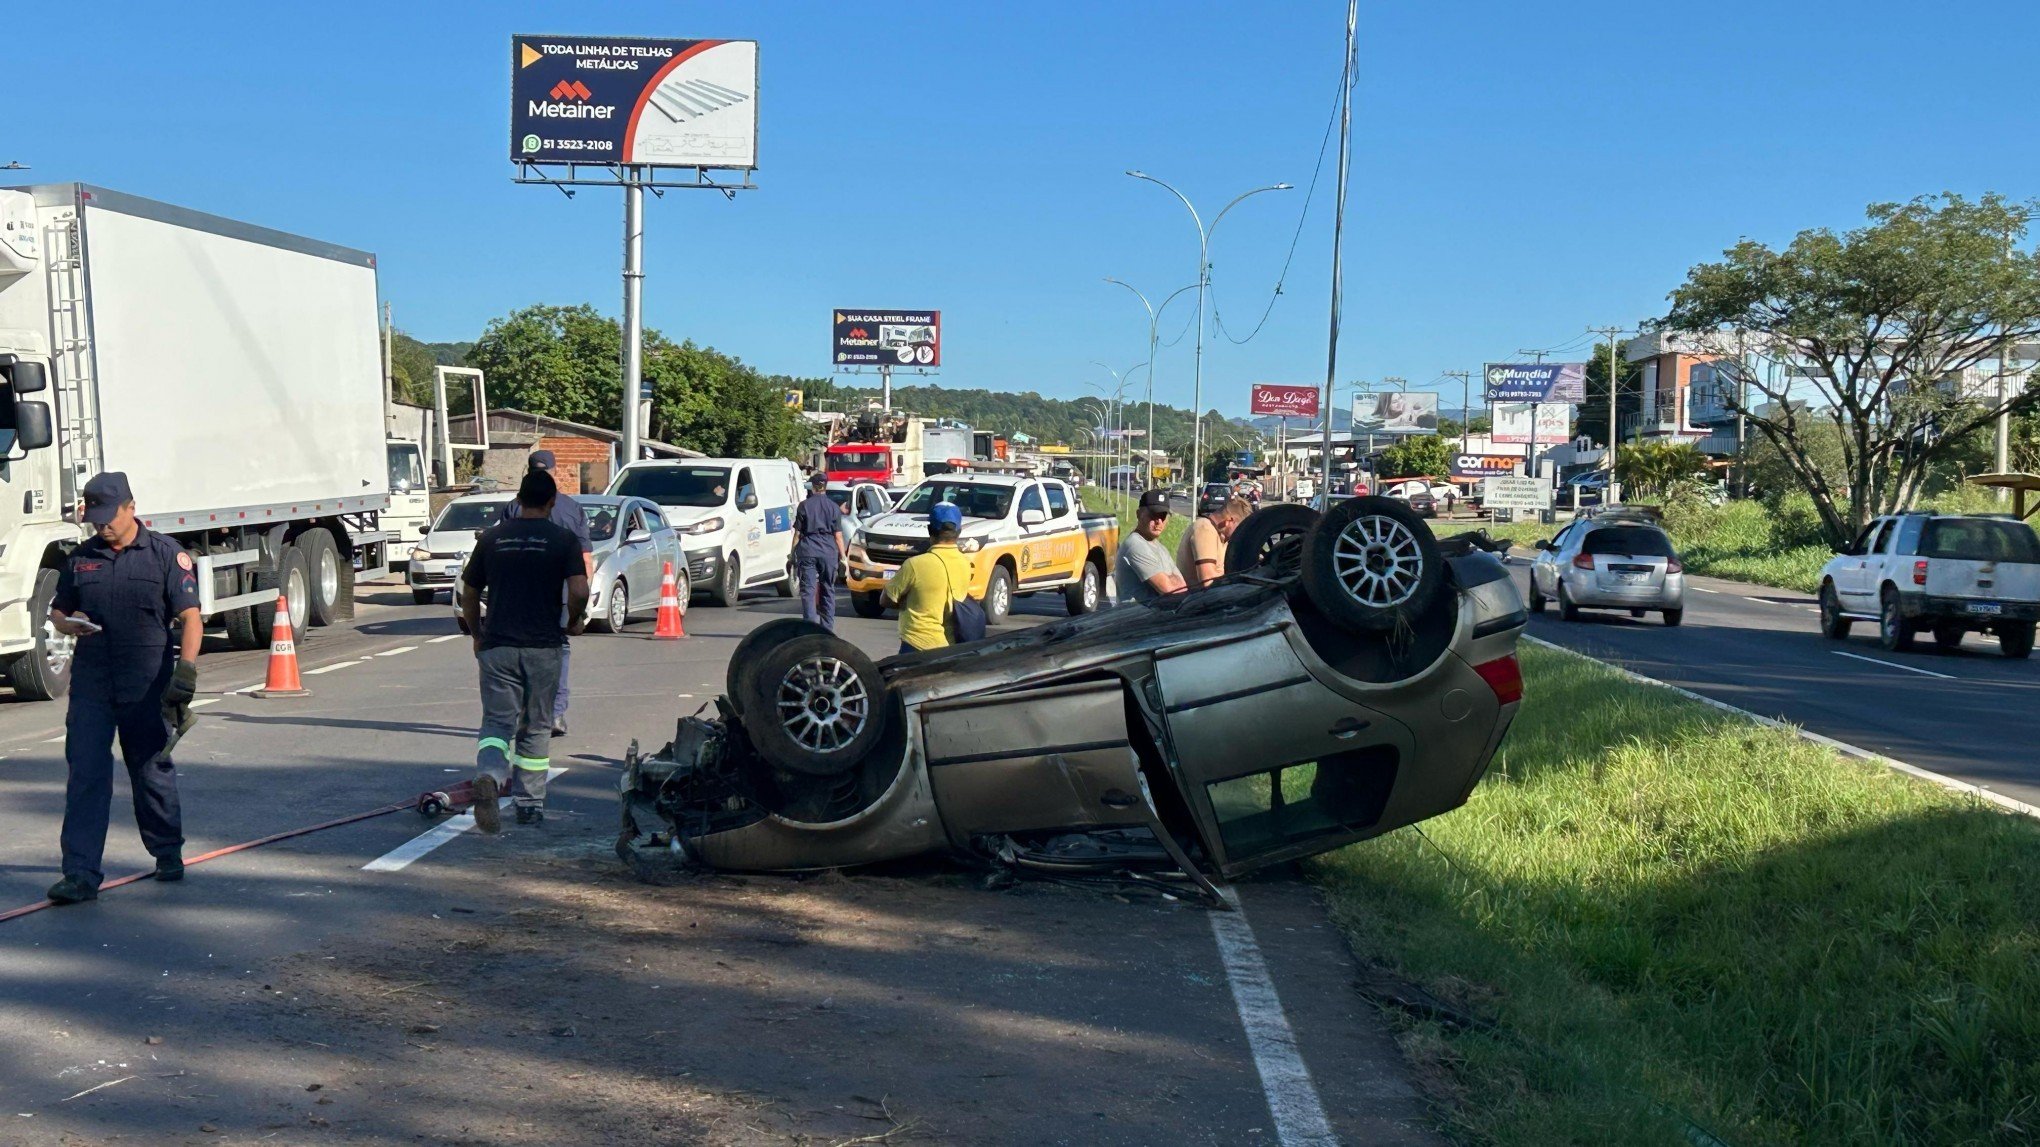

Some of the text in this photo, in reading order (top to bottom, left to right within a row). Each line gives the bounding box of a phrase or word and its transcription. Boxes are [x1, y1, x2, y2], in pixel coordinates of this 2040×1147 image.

[542, 44, 673, 57] TODA LINHA DE TELHAS
[576, 57, 639, 70] METÁLICAS
[528, 99, 615, 119] Metainer
[543, 139, 613, 150] 51 3523-2108
[883, 315, 905, 323] STEEL
[840, 337, 879, 346] Metainer
[1504, 368, 1552, 380] Mundial
